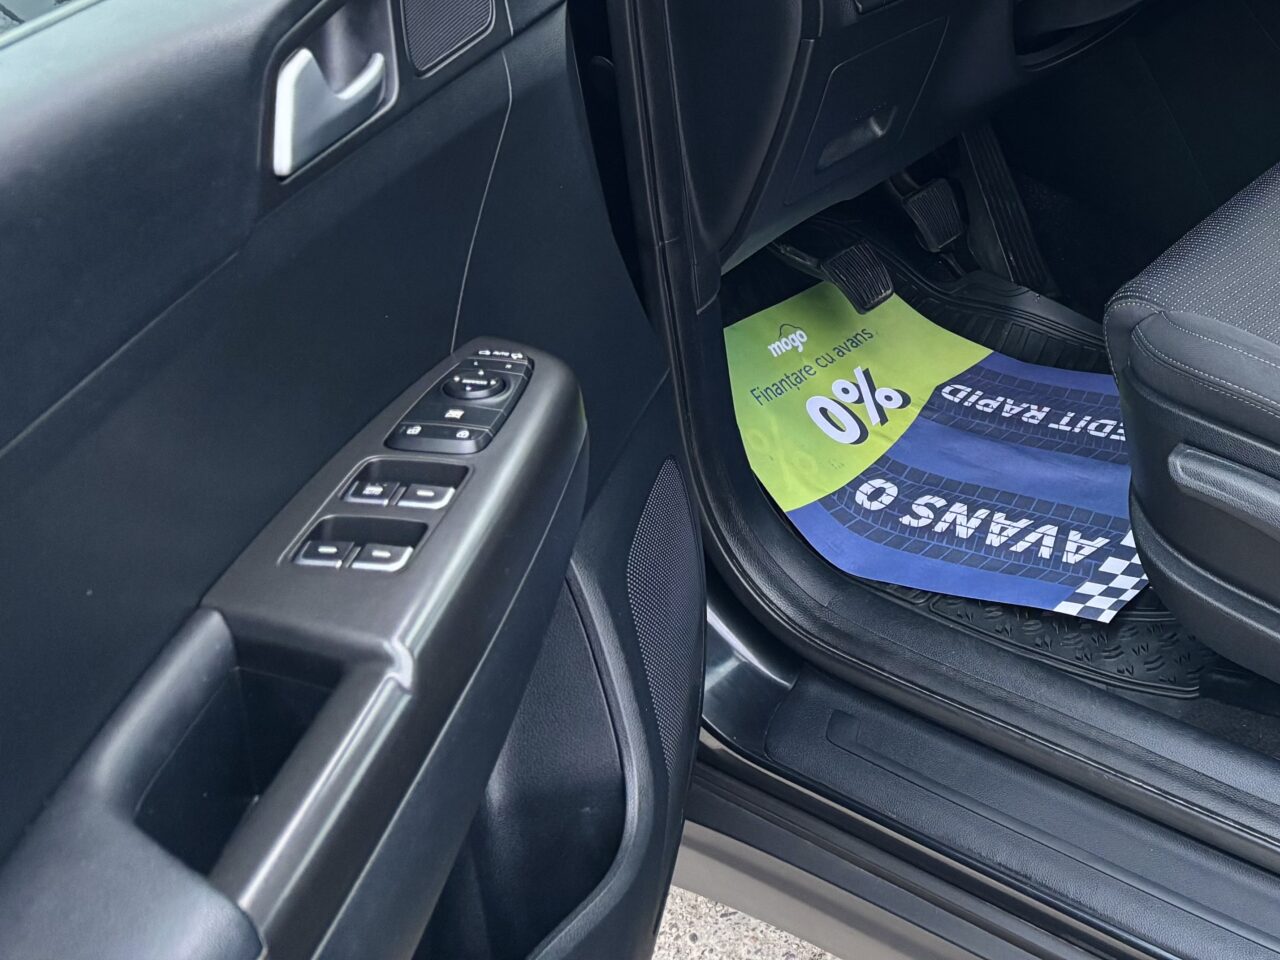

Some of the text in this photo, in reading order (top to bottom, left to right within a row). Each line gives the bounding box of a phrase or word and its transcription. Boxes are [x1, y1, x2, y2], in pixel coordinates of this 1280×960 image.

[768, 329, 808, 358] mogo
[815, 351, 836, 368] cu
[832, 328, 874, 358] avans
[805, 366, 912, 445] 0%
[941, 383, 1051, 425] RAPID
[899, 494, 1111, 564] AVANS
